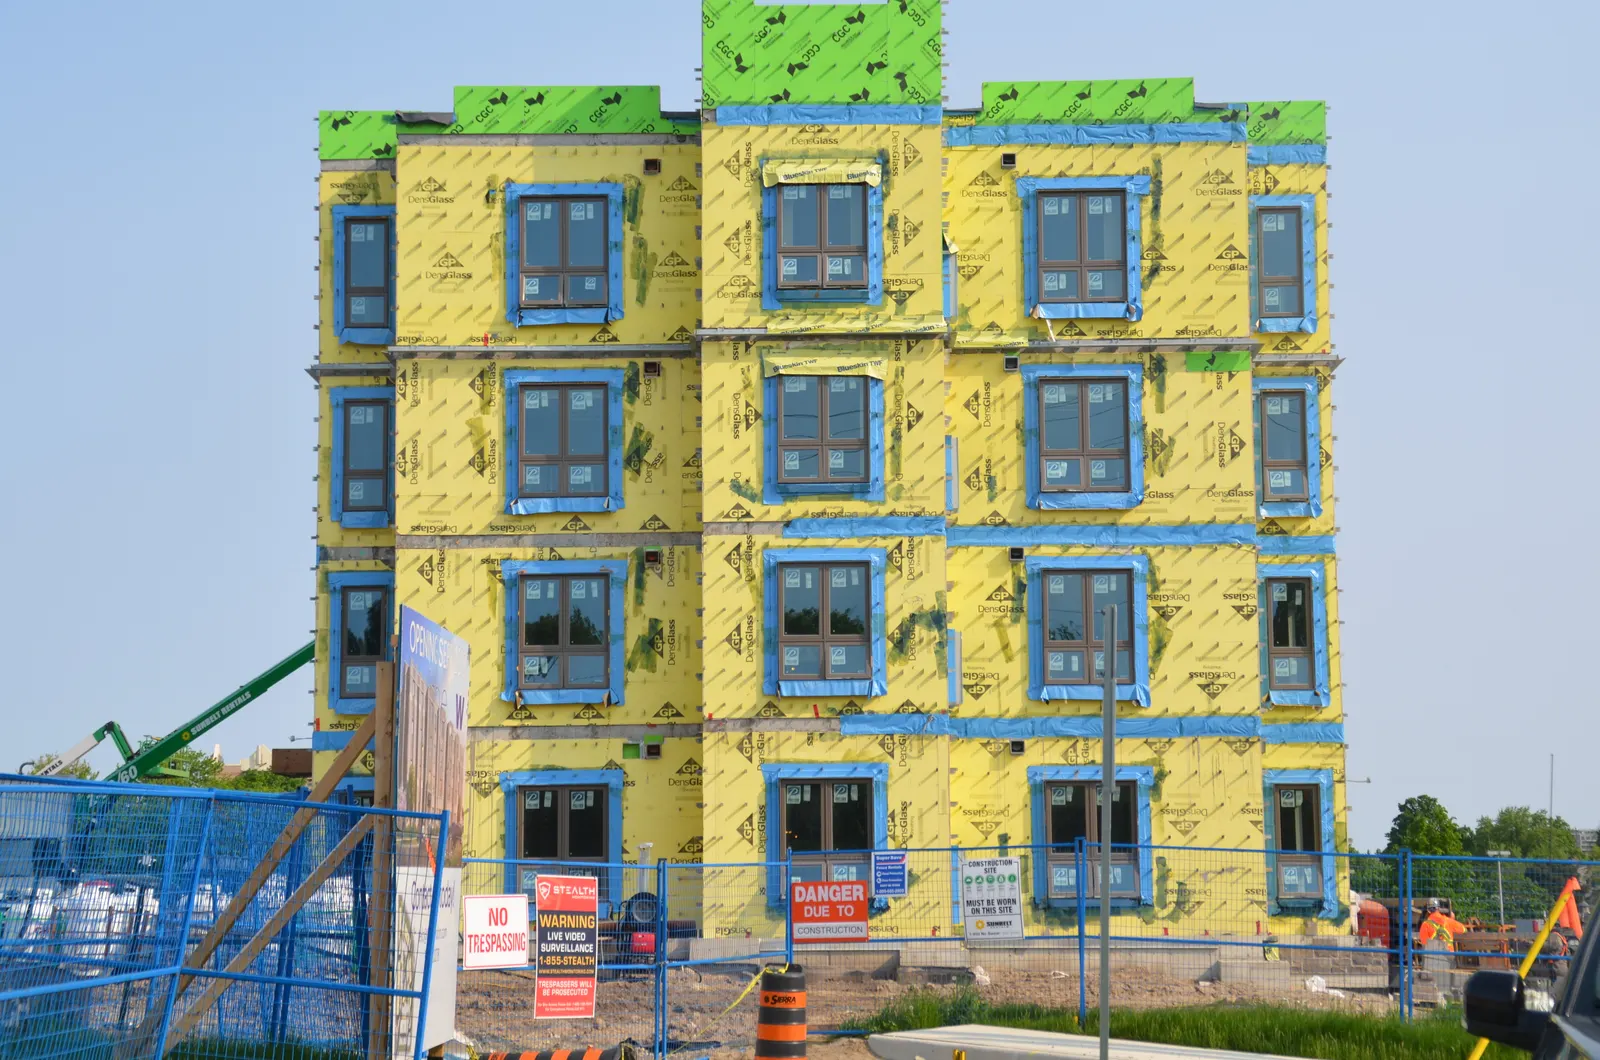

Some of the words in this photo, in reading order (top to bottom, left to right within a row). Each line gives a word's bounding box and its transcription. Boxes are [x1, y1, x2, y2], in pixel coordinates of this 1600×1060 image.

[702, 11, 714, 28] CG
[907, 8, 926, 27] CGC
[754, 25, 772, 44] CGC
[832, 24, 851, 43] CGC
[716, 40, 735, 59] CGC
[802, 44, 821, 62] CGC
[702, 89, 714, 106] CG
[907, 86, 926, 104] CGC
[986, 101, 1005, 120] CGC
[1063, 100, 1082, 118] CGC
[1114, 98, 1133, 117] CGC
[475, 106, 494, 124] CGC
[589, 106, 608, 124] CGC
[1248, 120, 1266, 138] CGC
[791, 136, 839, 145] DensGlass
[891, 130, 900, 177] DensGlass
[744, 141, 752, 188] DensGlass
[974, 176, 992, 185] GP
[1209, 174, 1227, 184] GP
[422, 184, 440, 192] GP
[673, 181, 690, 190] GP
[961, 189, 1008, 198] DensGlass
[1196, 187, 1242, 196] DensGlass
[408, 196, 454, 204] DensGlass
[659, 194, 695, 202] DensGla
[744, 220, 752, 266] DensGlass
[1143, 251, 1161, 260] GP
[1222, 250, 1240, 259] GP
[439, 258, 457, 267] GP
[665, 256, 682, 266] GP
[1209, 263, 1248, 272] DensGlas
[425, 271, 472, 279] DensGlass
[652, 270, 697, 278] DensGlass
[731, 276, 748, 286] GP
[717, 290, 763, 299] DensGlass
[595, 332, 613, 342] GP
[673, 332, 690, 340] GP
[1062, 328, 1080, 336] GP
[1097, 328, 1143, 338] DensGlass
[1176, 329, 1222, 337] DensGlass
[1278, 341, 1296, 350] GP
[837, 362, 868, 372] Blueskin
[410, 362, 418, 408] DensGlass
[475, 376, 484, 394] GP
[488, 362, 496, 407] DensGlass
[970, 396, 978, 414] GP
[747, 406, 755, 424] GP
[908, 408, 916, 424] GP
[1218, 422, 1226, 468] DensGlass
[1232, 436, 1240, 452] GP
[410, 439, 418, 484] DensGlass
[475, 454, 484, 470] GP
[488, 439, 496, 484] DensGlass
[1207, 490, 1254, 498] DensGlass
[730, 510, 746, 518] GP
[567, 521, 584, 530] GP
[646, 520, 663, 530] GP
[986, 516, 1004, 526] GP
[411, 525, 457, 534] DensGlass
[490, 525, 536, 534] DensGlass
[731, 550, 740, 568] GP
[893, 548, 902, 566] GP
[424, 562, 432, 578] GP
[992, 592, 1008, 600] GP
[978, 606, 1024, 614] DensGlass
[668, 619, 676, 665] DensGlass
[733, 630, 741, 648] GP
[746, 615, 754, 662] DensGlass
[963, 672, 1000, 680] DensGla
[1189, 672, 1236, 680] DensGlass
[190, 711, 221, 736] SUNBELT
[220, 691, 252, 716] RENTALS
[512, 710, 530, 719] GP
[580, 710, 597, 718] GP
[660, 708, 677, 717] GP
[761, 708, 778, 716] GP
[843, 706, 860, 715] GP
[900, 706, 916, 714] GP
[744, 740, 752, 756] GP
[886, 736, 894, 754] GP
[682, 764, 699, 773] GP
[963, 810, 1009, 818] DensGlass
[1160, 808, 1208, 816] DensGlass
[744, 821, 753, 838] GP
[758, 804, 766, 853] DensGlass
[968, 860, 1012, 868] CONSTRUCTION
[553, 886, 596, 896] STEALTH
[795, 884, 864, 902] DANGER
[966, 900, 984, 908] MUST
[996, 898, 1016, 906] WORN
[804, 906, 830, 918] DUE
[836, 905, 854, 916] TO
[998, 906, 1012, 914] SITE
[488, 908, 508, 926] NO
[540, 914, 595, 928] WARNING
[798, 924, 864, 935] CONSTRUCTION
[548, 932, 562, 940] LIVE
[565, 932, 586, 942] VIDEO
[468, 932, 526, 954] TRESPASSING
[541, 944, 594, 952] SURVEILLANCE
[540, 956, 594, 966] 1-855-STEALTH
[539, 980, 578, 988] TRESPASSERS
[580, 980, 592, 988] WILL
[542, 988, 550, 996] BE
[552, 988, 588, 996] PROSECUTED
[770, 994, 796, 1005] SIERRA
